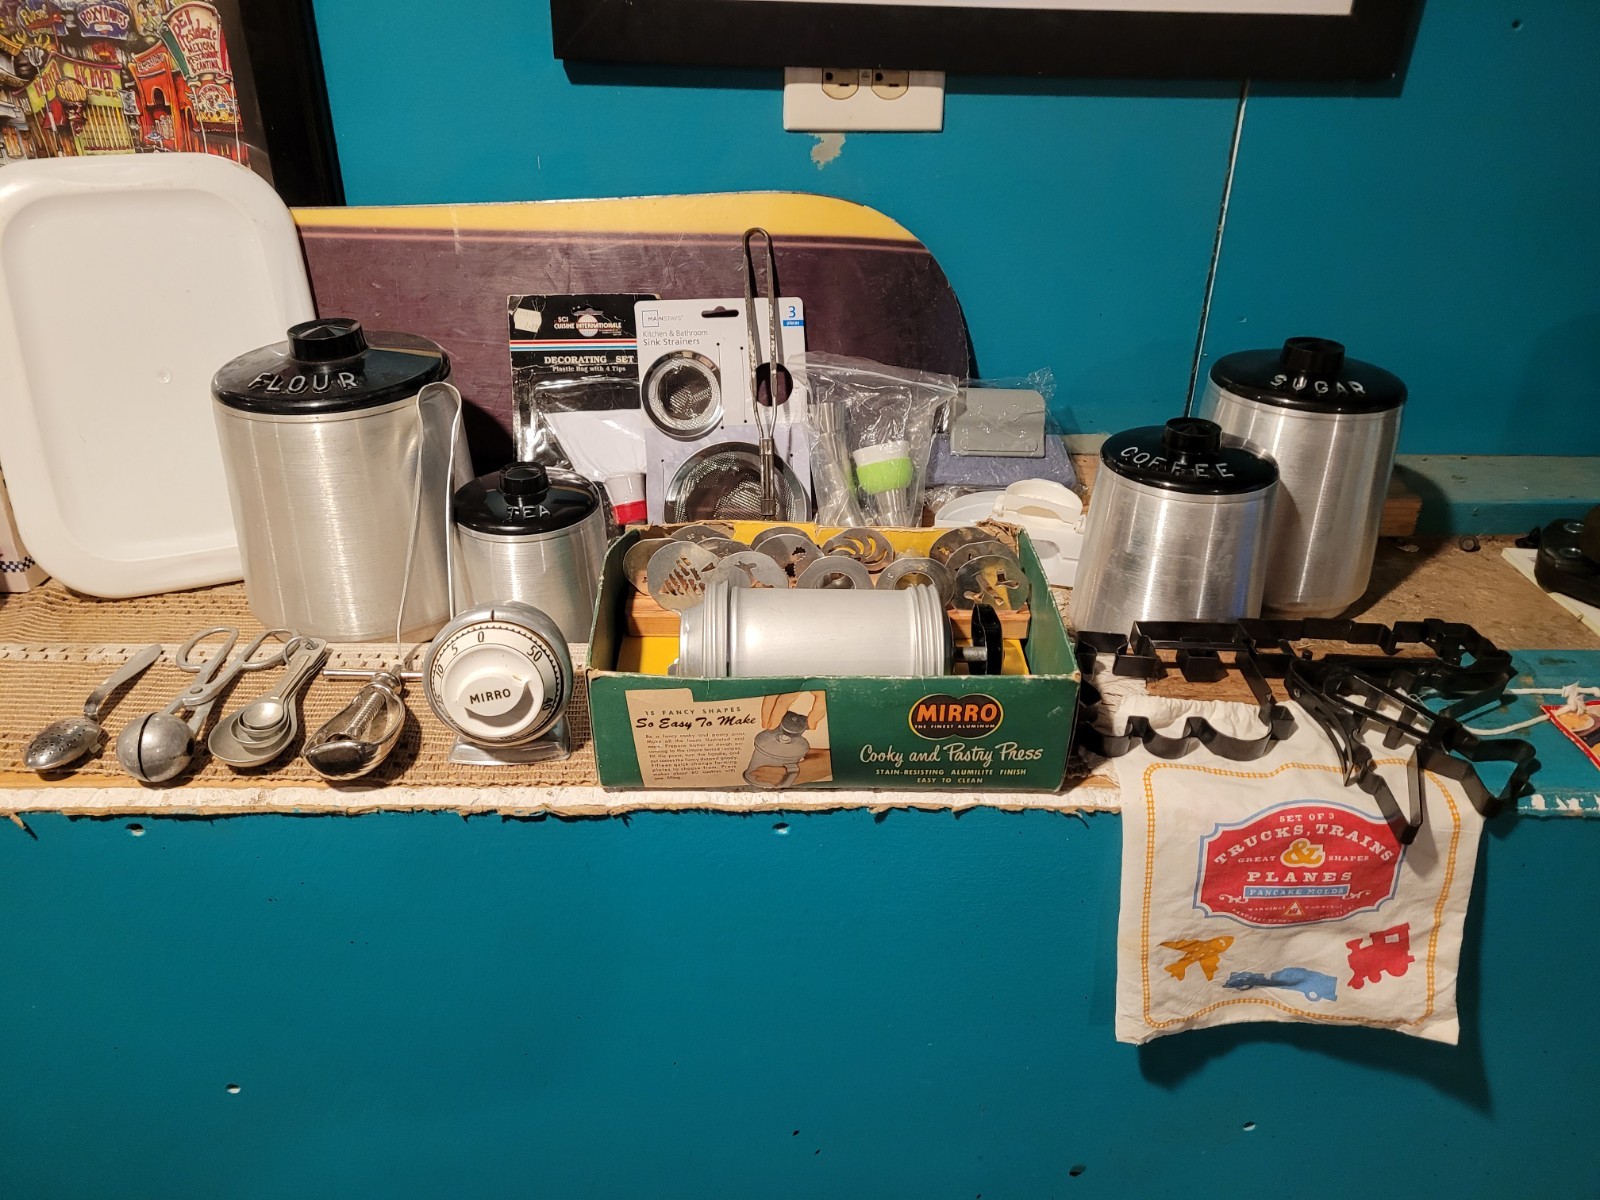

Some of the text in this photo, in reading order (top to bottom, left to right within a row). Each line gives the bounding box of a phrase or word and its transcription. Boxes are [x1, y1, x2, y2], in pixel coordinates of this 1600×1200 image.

[788, 306, 796, 318] 3
[643, 337, 700, 346] Sink Strainers
[544, 356, 634, 364] DECORATING SET
[248, 372, 358, 394] FLOUR
[1270, 374, 1366, 394] SUGAR
[1120, 446, 1234, 478] COFFEE
[507, 505, 551, 520] TEA
[477, 630, 485, 643] 0
[451, 643, 459, 656] 5
[526, 645, 543, 662] 50
[436, 664, 444, 679] 10
[470, 688, 511, 704] MIRRO
[916, 704, 998, 722] MIRRO
[636, 714, 756, 730] So Easy To Make
[860, 741, 1044, 768] Cooky and Pastry Press
[1280, 814, 1302, 822] SET
[1214, 824, 1394, 864] TRUCKS, TRAINS
[1280, 838, 1326, 868] &
[1247, 871, 1352, 882] PLANES
[1250, 888, 1302, 896] PANCAKE
